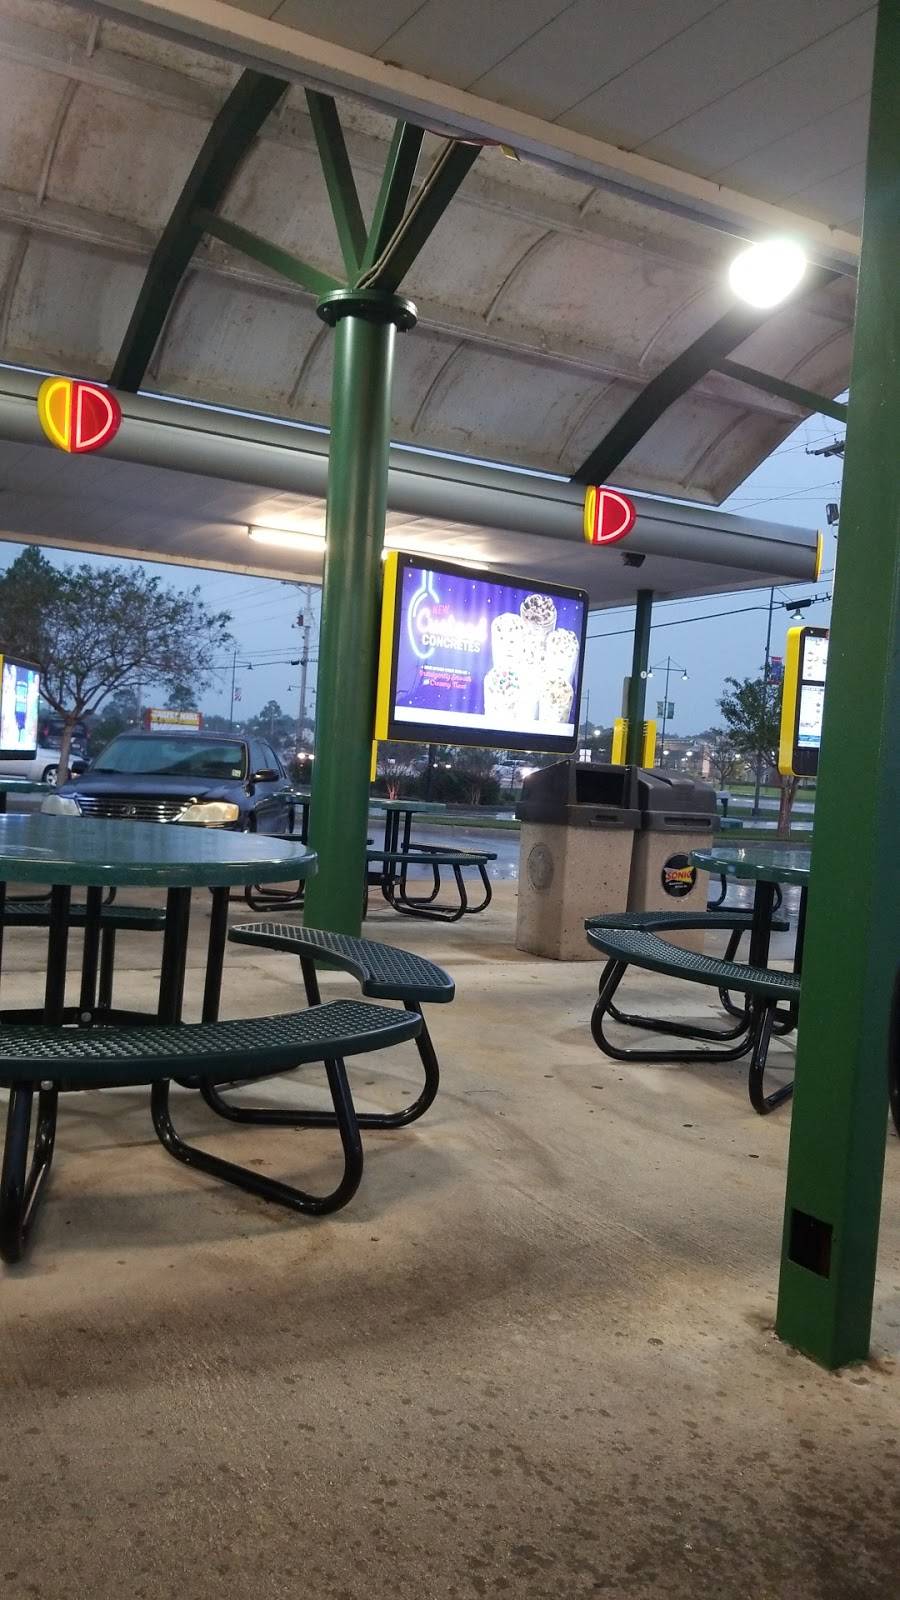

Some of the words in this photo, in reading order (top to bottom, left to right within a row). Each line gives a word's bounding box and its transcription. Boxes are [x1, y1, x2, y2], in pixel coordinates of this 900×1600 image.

[432, 604, 450, 616] NEW
[422, 634, 481, 653] CONCRETES
[667, 871, 692, 880] SONIC
